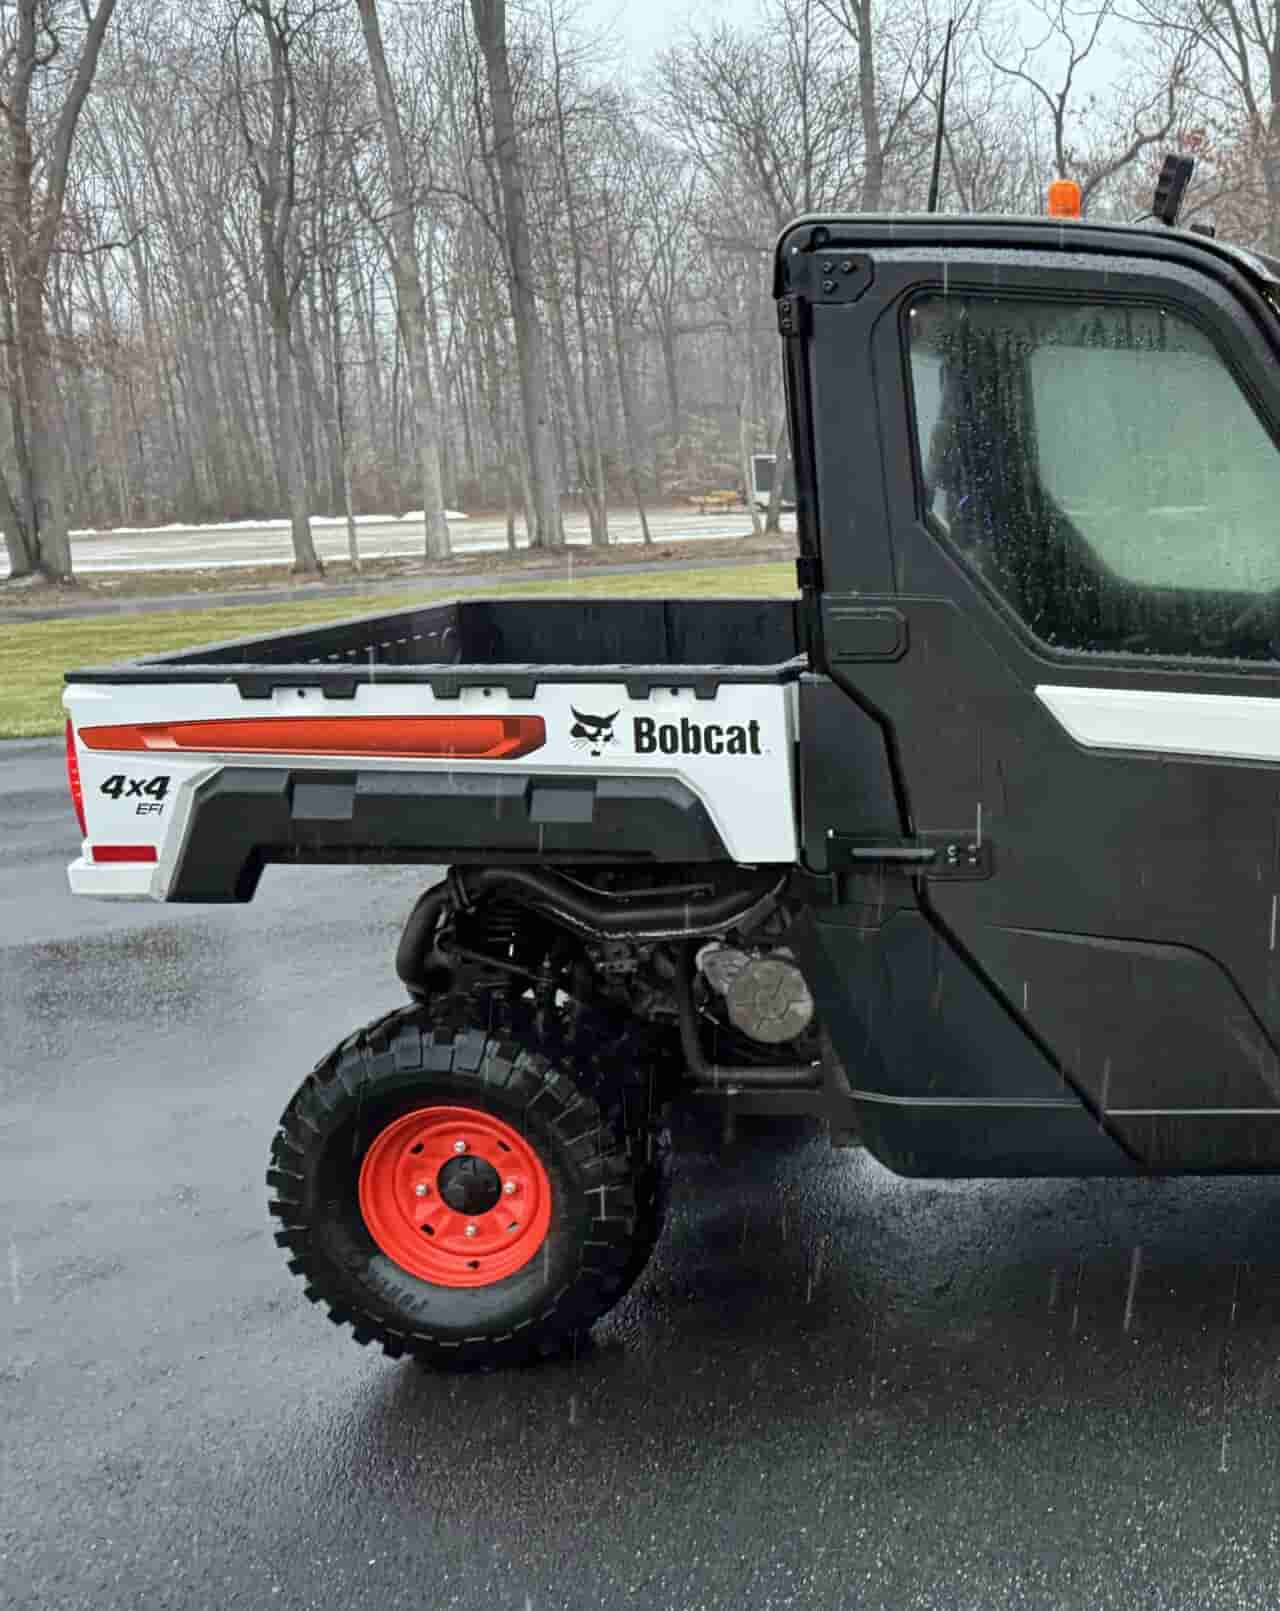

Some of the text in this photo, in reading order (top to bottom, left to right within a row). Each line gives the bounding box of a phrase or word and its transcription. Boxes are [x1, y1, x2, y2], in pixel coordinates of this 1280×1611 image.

[633, 716, 762, 755] Bobcat
[99, 775, 171, 801] 4x4
[135, 802, 164, 816] EFI
